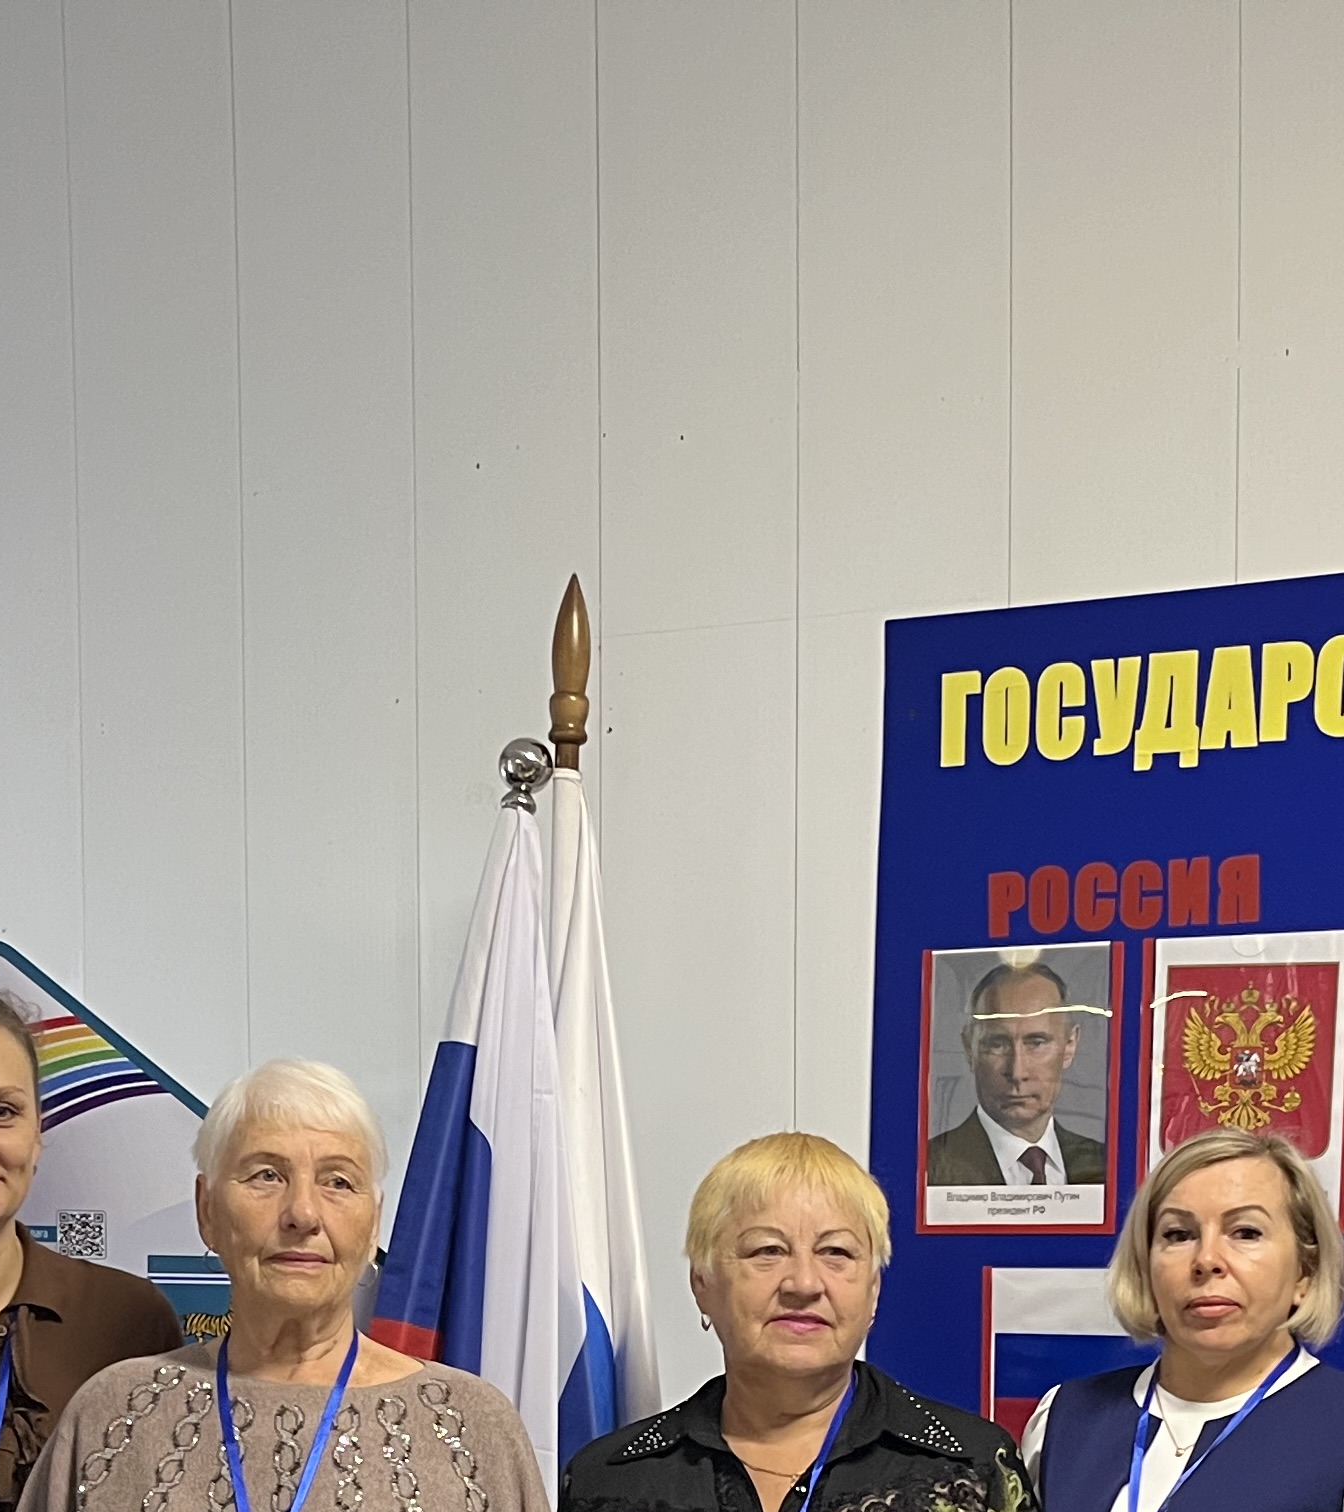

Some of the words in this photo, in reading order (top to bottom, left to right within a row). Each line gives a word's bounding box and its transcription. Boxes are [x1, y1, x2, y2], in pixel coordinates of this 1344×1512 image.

[987, 853, 1262, 938] РОССИЯ
[1054, 1190, 1080, 1203] Путин
[1032, 1205, 1046, 1214] РФ
